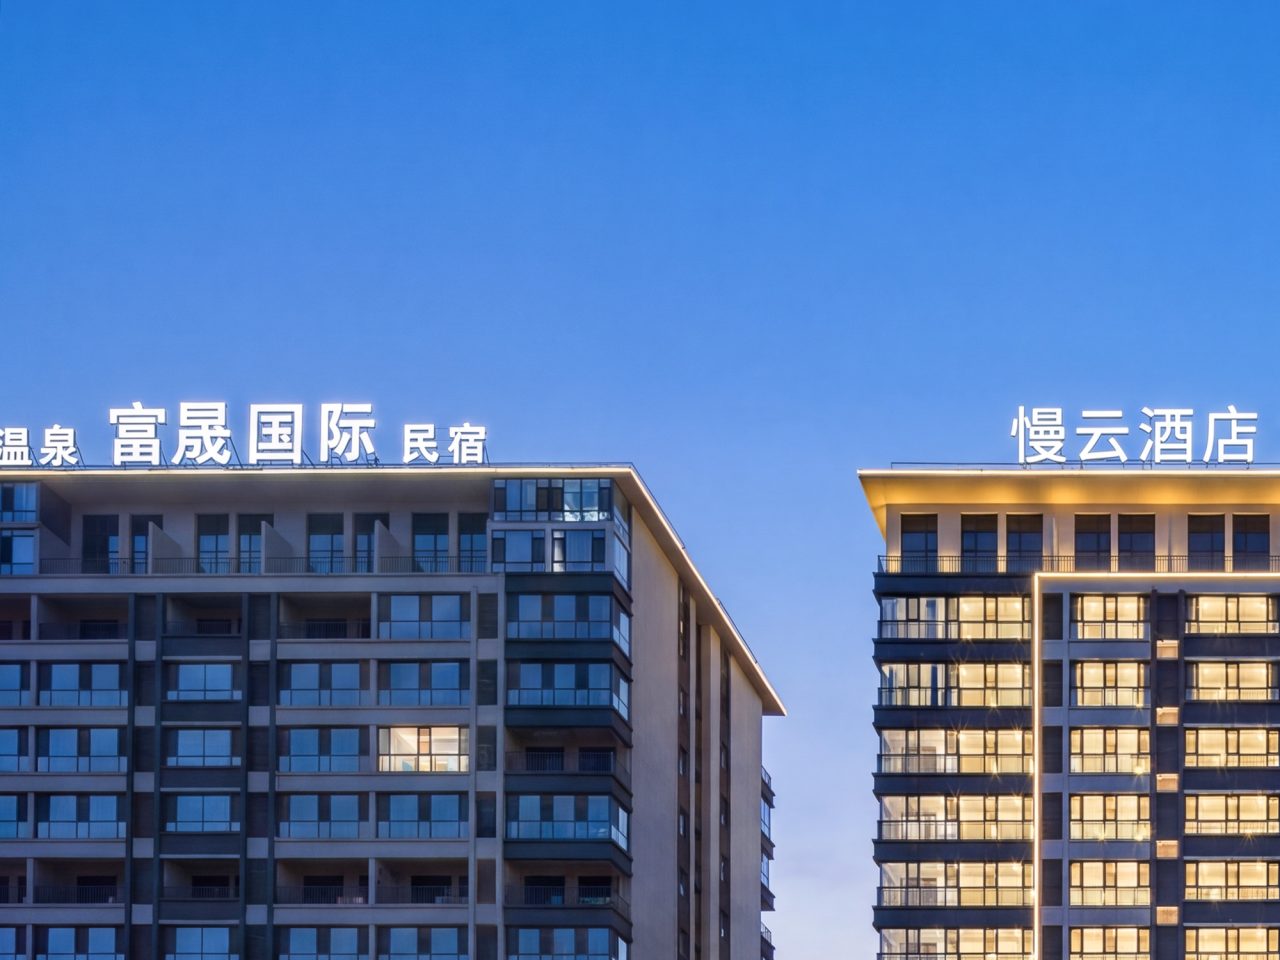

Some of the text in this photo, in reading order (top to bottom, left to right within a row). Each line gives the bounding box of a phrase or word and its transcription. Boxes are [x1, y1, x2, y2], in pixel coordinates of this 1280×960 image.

[0, 401, 486, 466] 温泉 富晟国际 民宿
[1011, 405, 1258, 463] 慢云酒店
